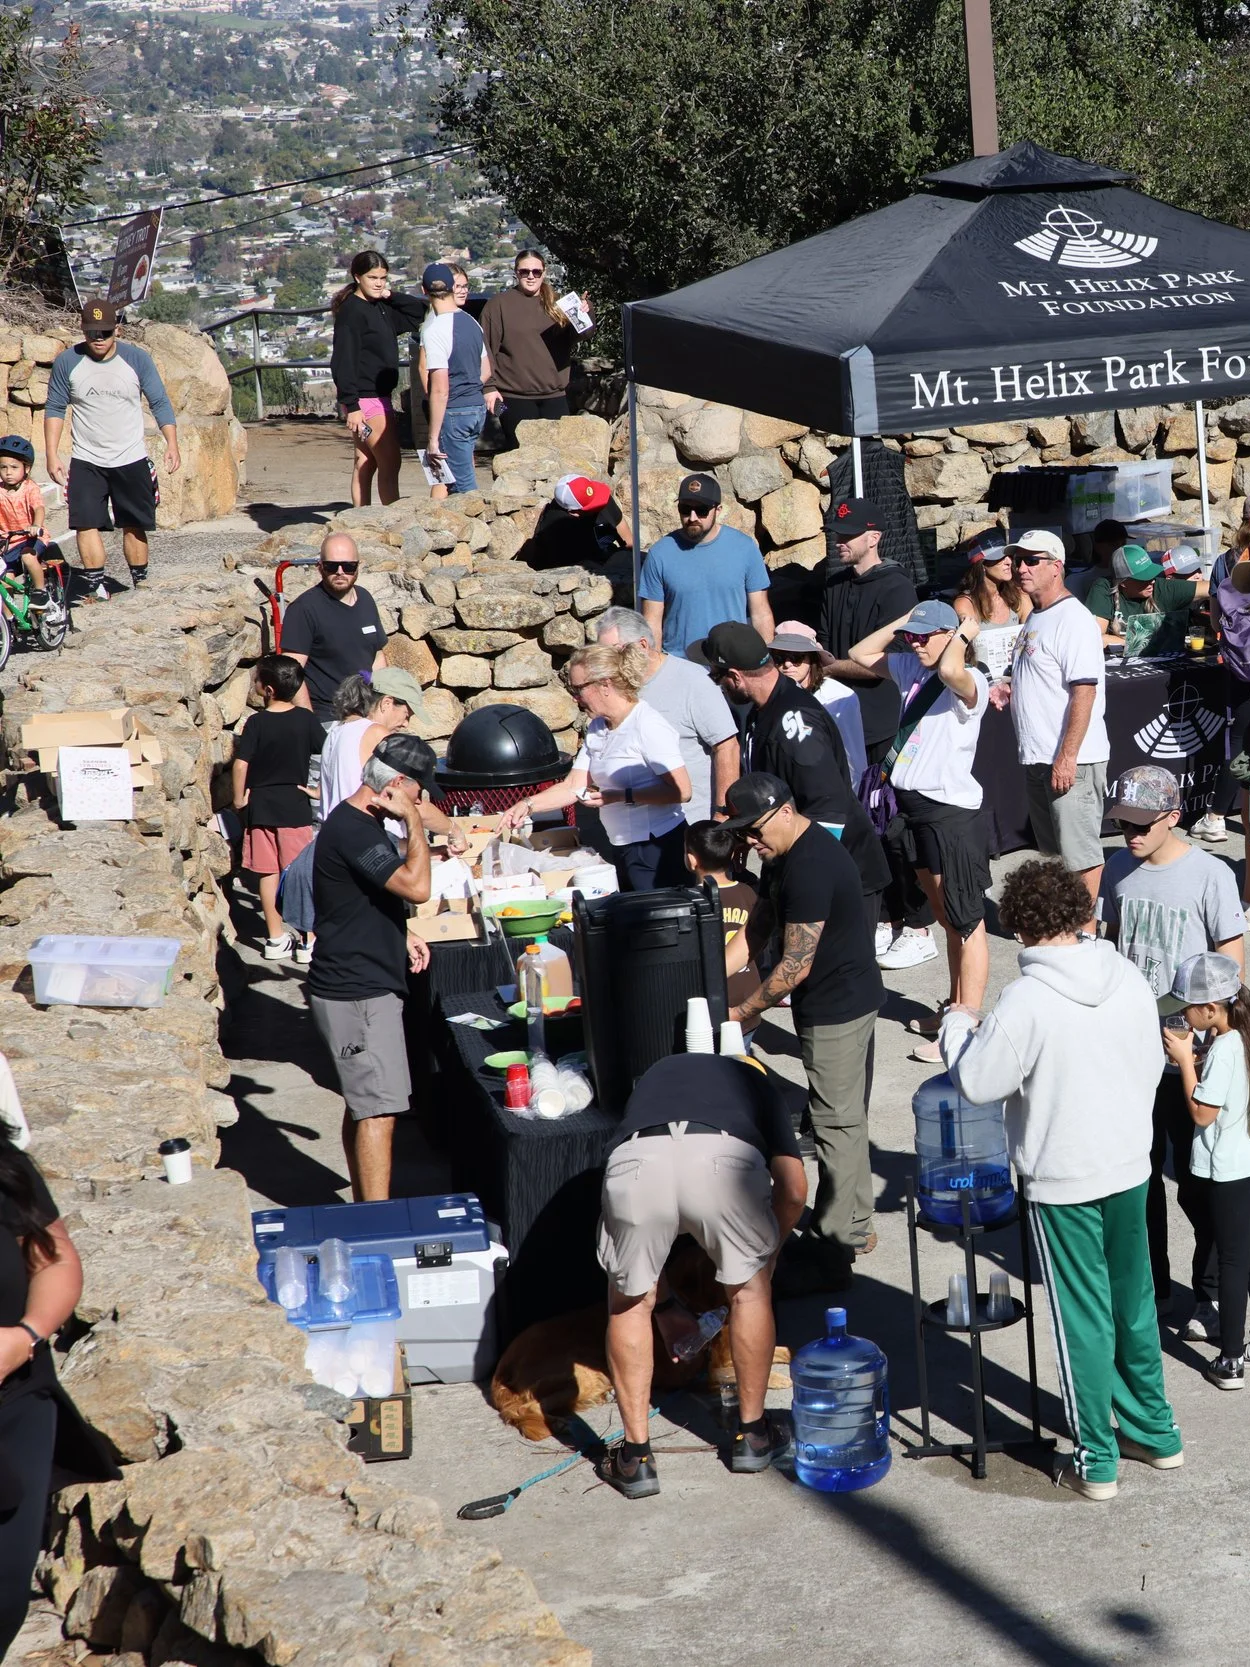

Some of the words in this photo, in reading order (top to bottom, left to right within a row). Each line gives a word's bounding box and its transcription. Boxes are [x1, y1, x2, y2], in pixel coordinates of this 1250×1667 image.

[1065, 277, 1158, 295] HELIX
[1158, 269, 1245, 289] PARK
[1038, 291, 1236, 316] FOUNDATION
[909, 370, 979, 410] Mt.
[990, 360, 1094, 403] Helix
[1101, 348, 1190, 393] Park
